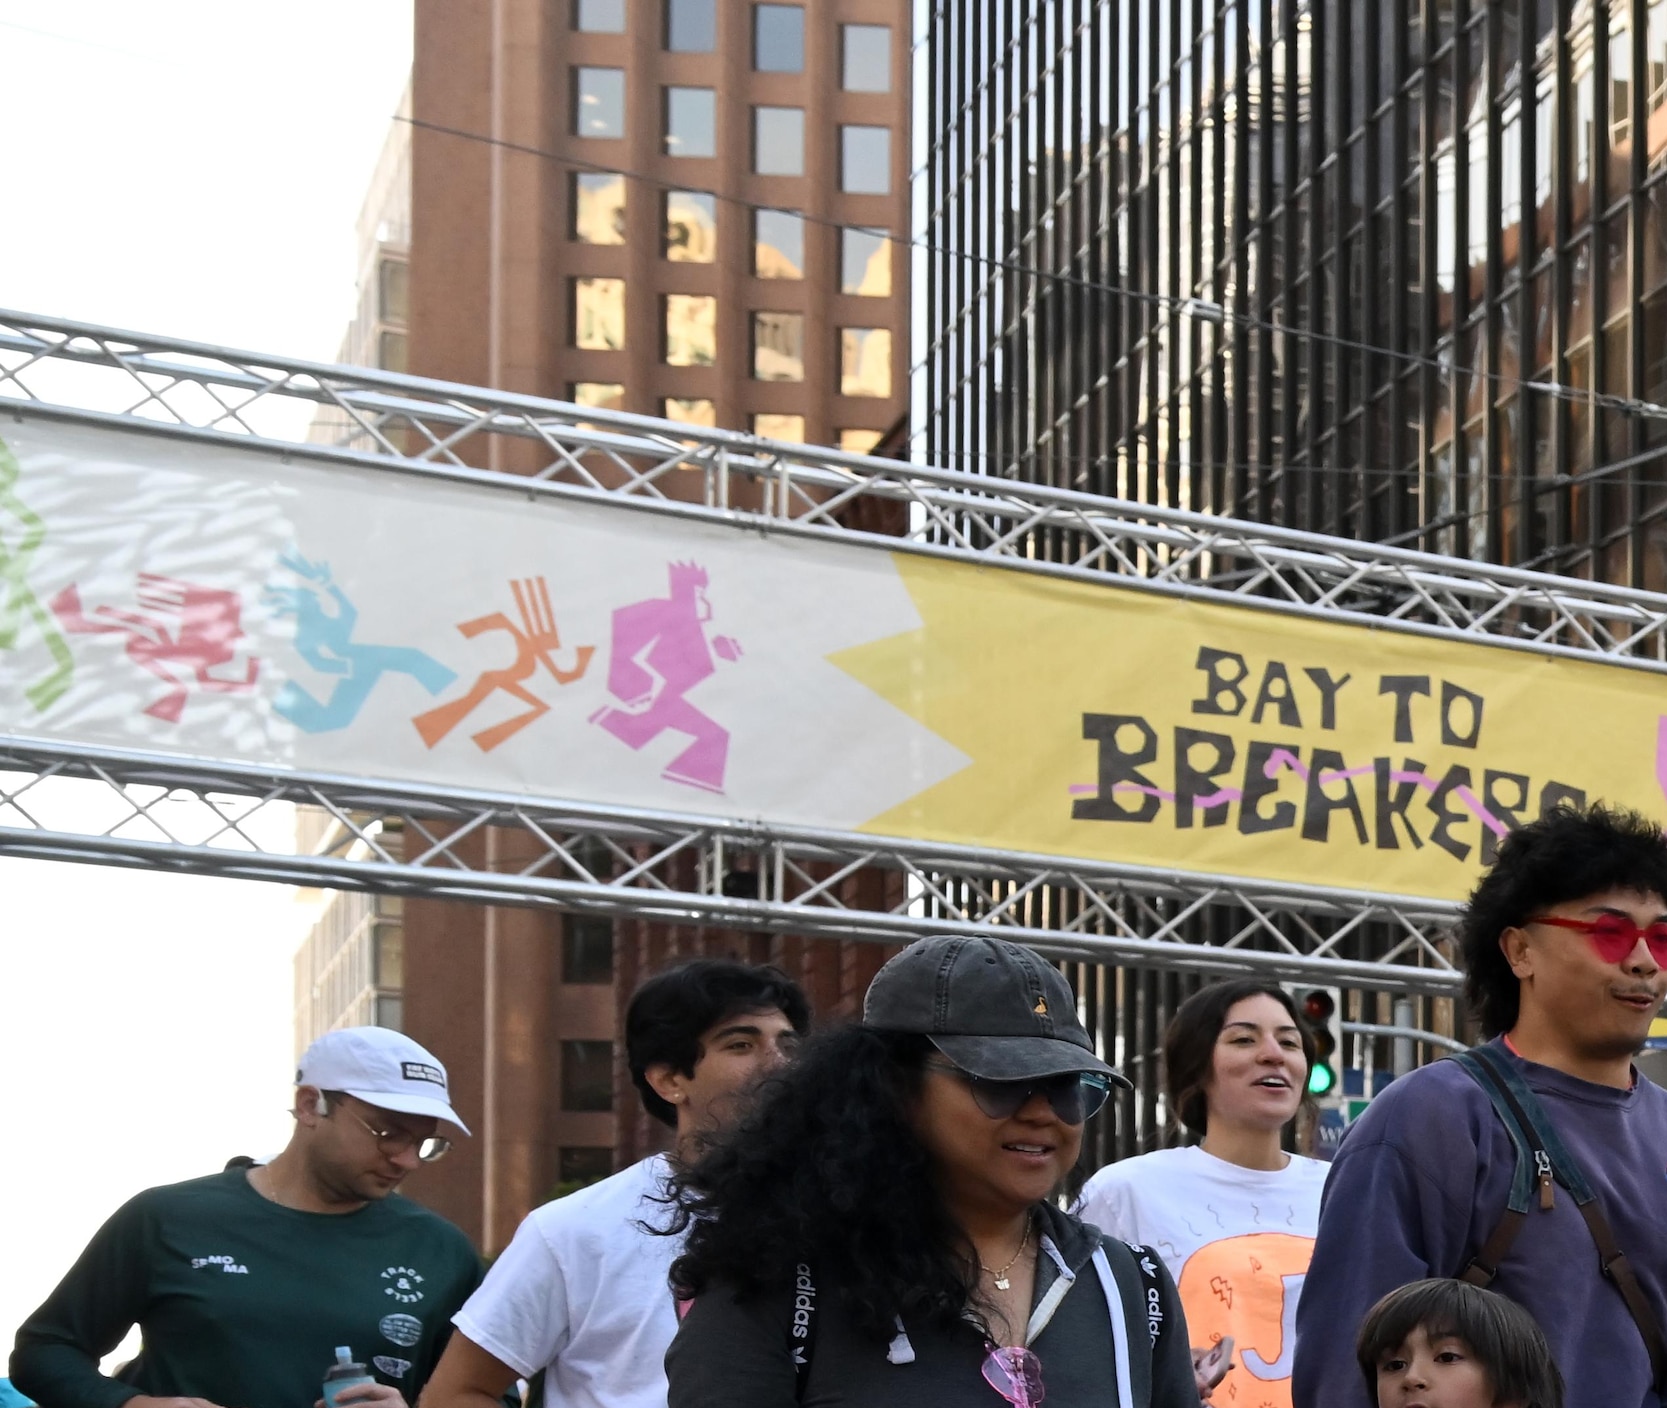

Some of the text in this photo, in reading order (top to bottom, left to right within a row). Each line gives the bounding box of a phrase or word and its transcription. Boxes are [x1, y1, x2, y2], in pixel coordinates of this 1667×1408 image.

[1191, 645, 1485, 749] BAY TO
[381, 1266, 425, 1283] TRACK
[792, 1263, 816, 1339] adidas
